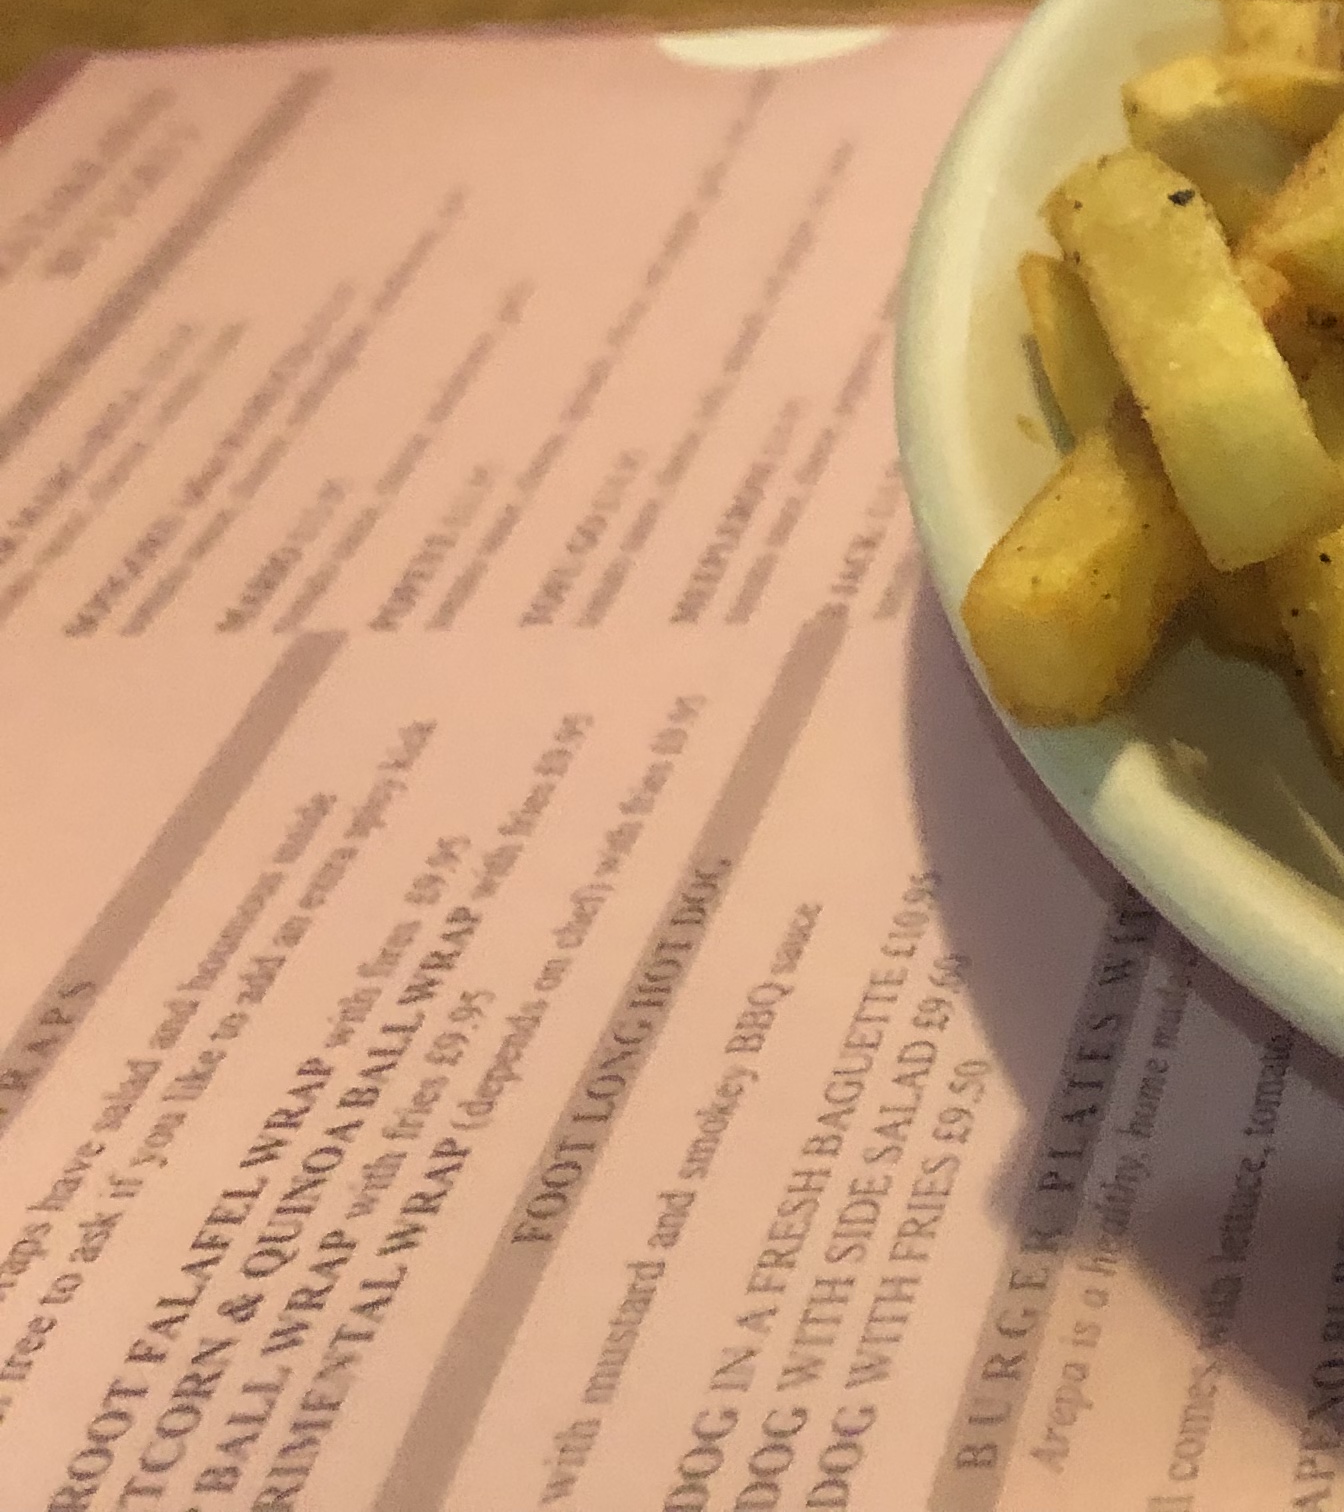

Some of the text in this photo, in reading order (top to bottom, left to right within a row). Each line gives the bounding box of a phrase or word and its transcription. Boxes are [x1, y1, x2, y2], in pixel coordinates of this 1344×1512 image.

[0, 981, 97, 1118] RAPS
[148, 998, 200, 1050] and
[217, 1292, 264, 1323] &
[241, 1118, 365, 1279] QUINOA
[336, 1010, 426, 1109] BALL
[396, 906, 483, 1005] WRAP
[470, 843, 524, 900] with
[511, 858, 733, 1245] FOOT LONG HOT DOG
[801, 965, 909, 1156] BAGUETTE
[92, 1059, 162, 1132] salad
[375, 1138, 473, 1257] WRAP
[533, 957, 572, 992] on
[1116, 1058, 1171, 1138] home
[0, 1314, 57, 1381] free
[38, 1272, 83, 1306] to
[69, 1210, 123, 1263] ask
[100, 1168, 143, 1199] if
[129, 1112, 188, 1169] you
[161, 1049, 227, 1101] like
[209, 1010, 249, 1041] to
[25, 1140, 105, 1211] have
[125, 1175, 268, 1362] FALAFEL
[239, 1056, 334, 1169] WRAP
[325, 987, 383, 1049] with
[744, 1167, 833, 1295] FRESH
[955, 886, 1155, 1470] BURGER PLATES WIT
[0, 1220, 52, 1300] raps
[194, 989, 497, 1493] BALL WRAP with fries £9.95
[538, 1417, 602, 1506] with
[579, 1260, 667, 1404] mustard
[647, 1190, 697, 1249] and
[677, 1065, 759, 1180] smokey
[725, 981, 795, 1054] BBQ
[734, 1406, 809, 1512] DOG
[776, 1275, 856, 1392] WITH
[823, 1174, 893, 1265] SIDE
[861, 1038, 939, 1165] SALAD
[805, 1059, 993, 1509] DOG WITH FRIES £9.50
[1082, 1288, 1110, 1309] a
[709, 1346, 760, 1393] IN
[736, 1304, 780, 1334] A
[1060, 1320, 1102, 1349] is
[661, 1407, 739, 1512] DOG
[1029, 1363, 1094, 1474] Arepa
[1167, 1359, 1223, 1482] comes
